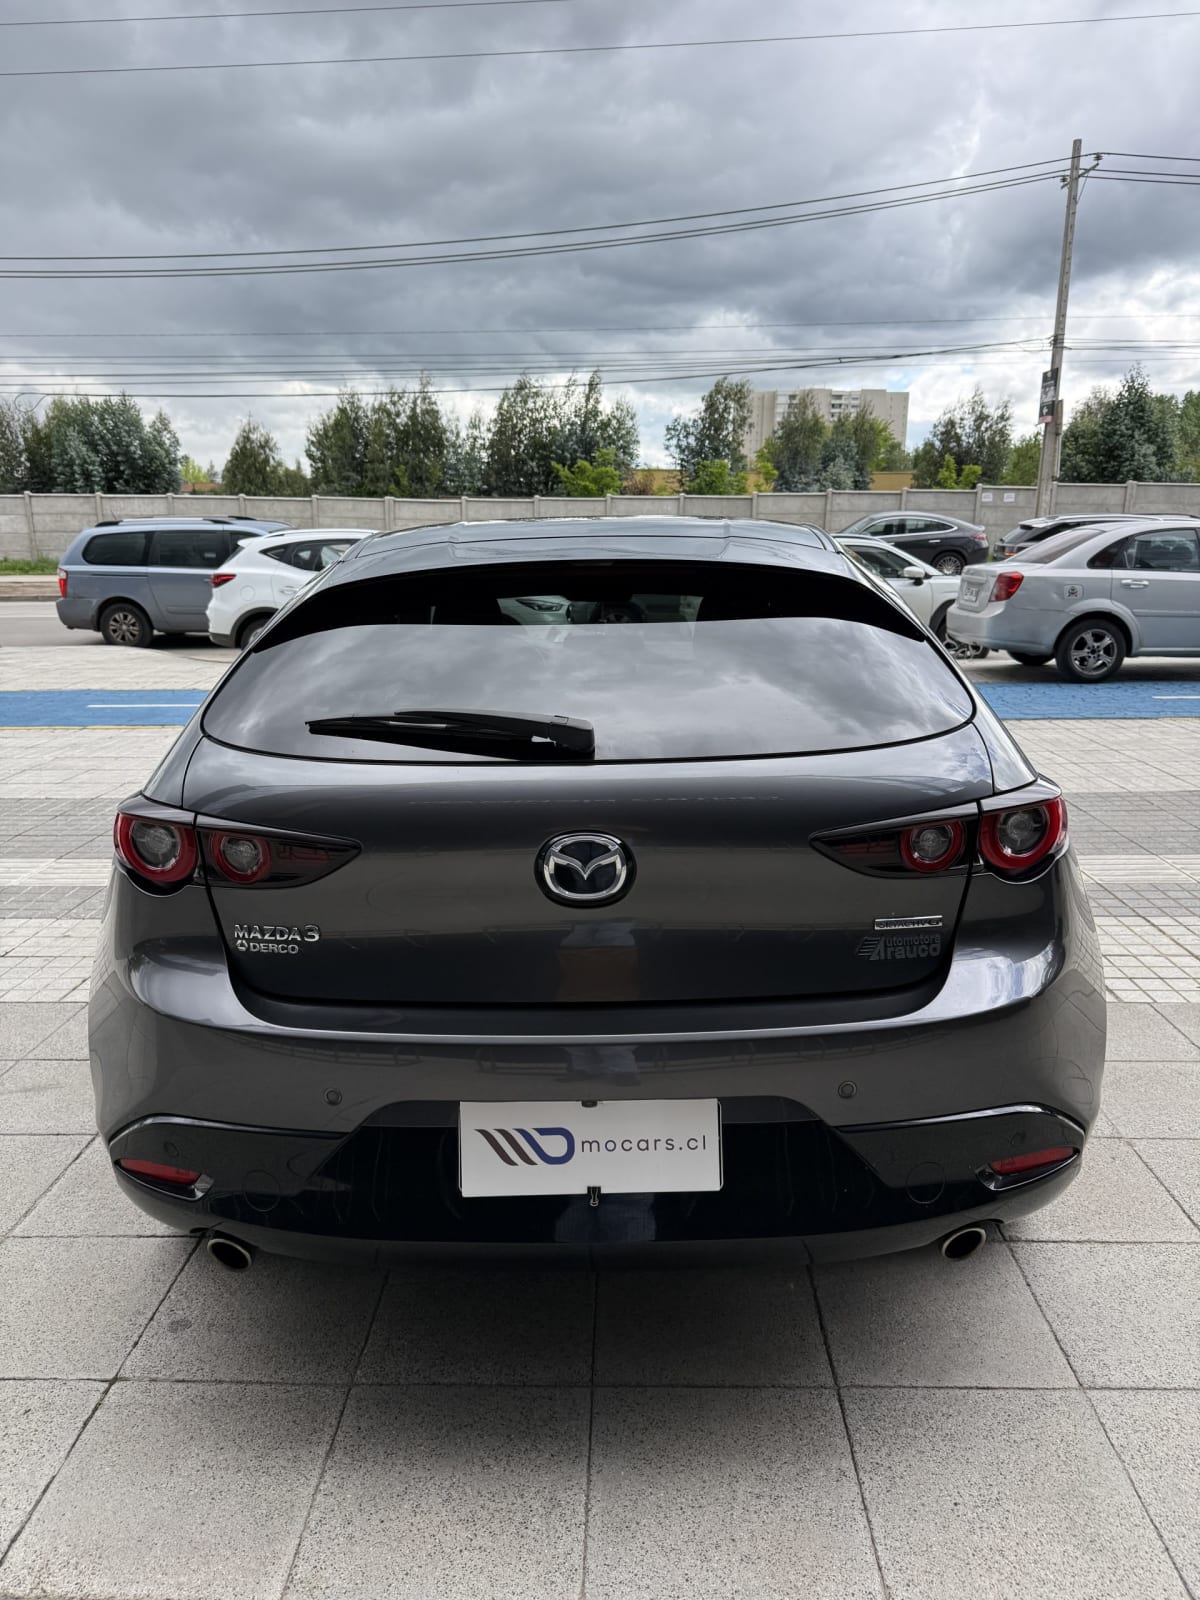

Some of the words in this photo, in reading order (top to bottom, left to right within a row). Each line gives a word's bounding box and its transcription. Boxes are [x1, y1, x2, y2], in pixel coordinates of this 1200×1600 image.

[249, 942, 299, 954] DERCO
[869, 936, 941, 960] Arauco
[581, 1134, 707, 1153] mocars.cl
